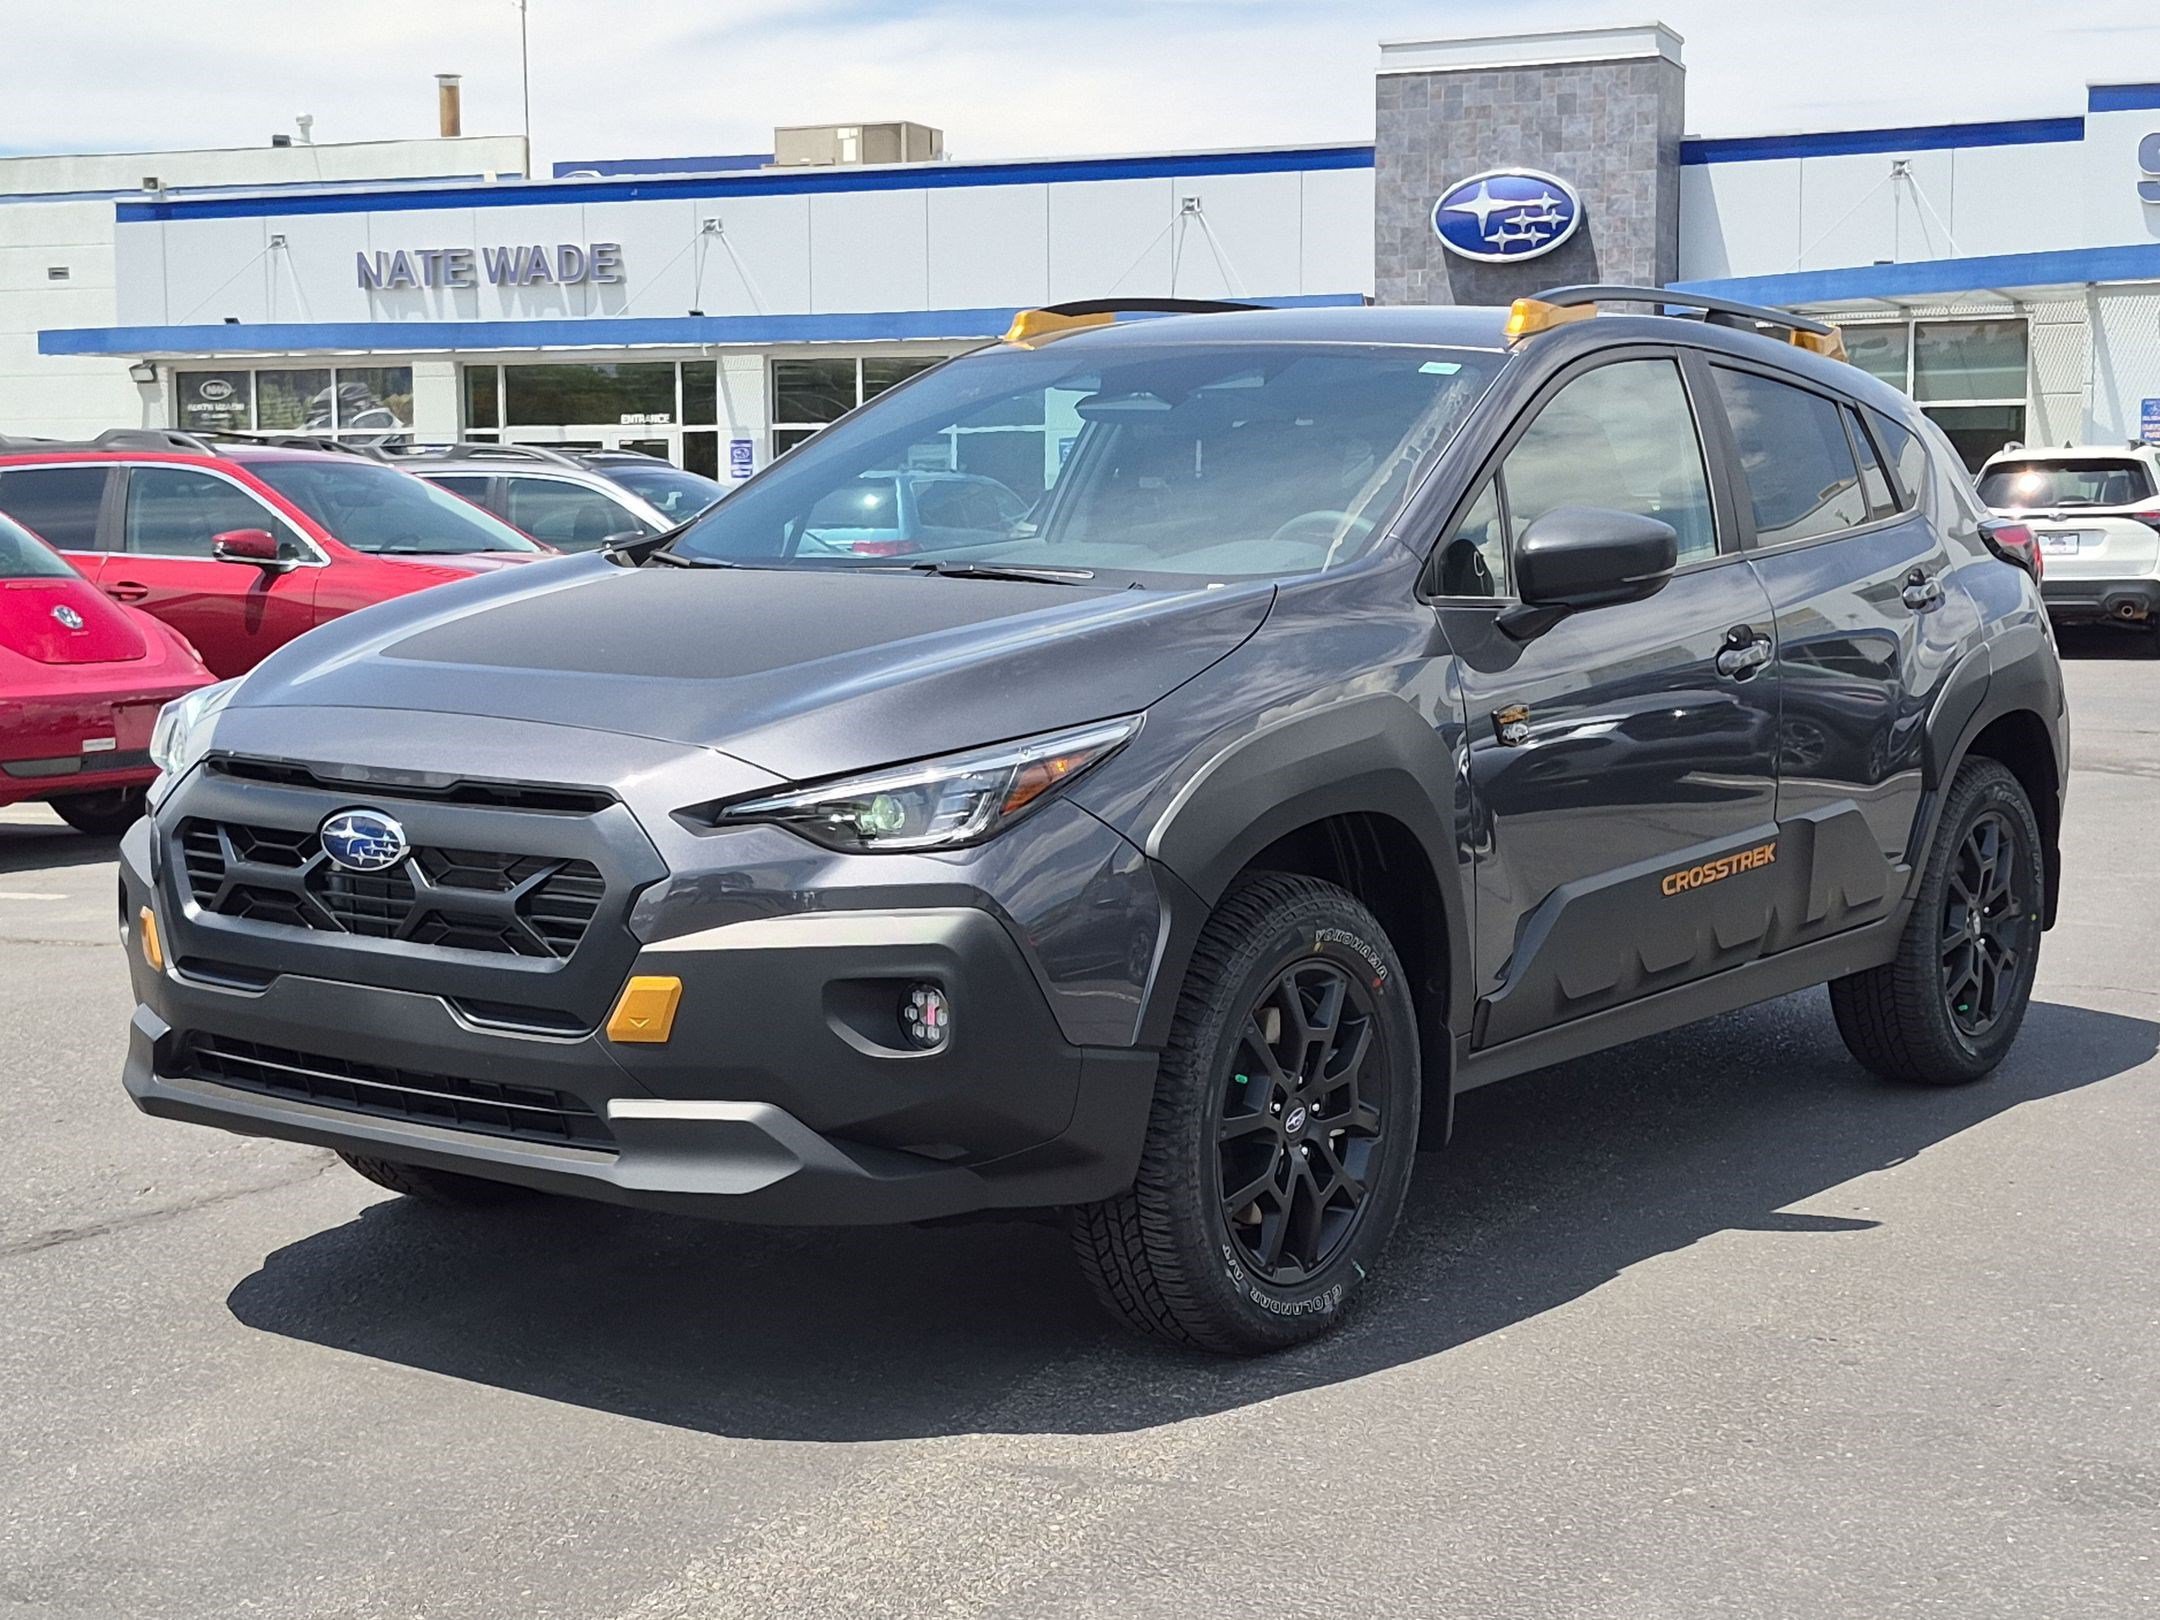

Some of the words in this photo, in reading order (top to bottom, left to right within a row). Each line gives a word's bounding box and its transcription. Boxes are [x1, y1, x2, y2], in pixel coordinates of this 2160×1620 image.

[356, 248, 478, 289] NATE
[482, 243, 626, 286] WADE
[621, 413, 670, 424] ENTRANCE
[1662, 842, 1776, 896] CROSSTREK
[1315, 928, 1388, 980] YOKOHAMA
[1249, 1284, 1343, 1315] GEOLANDAR
